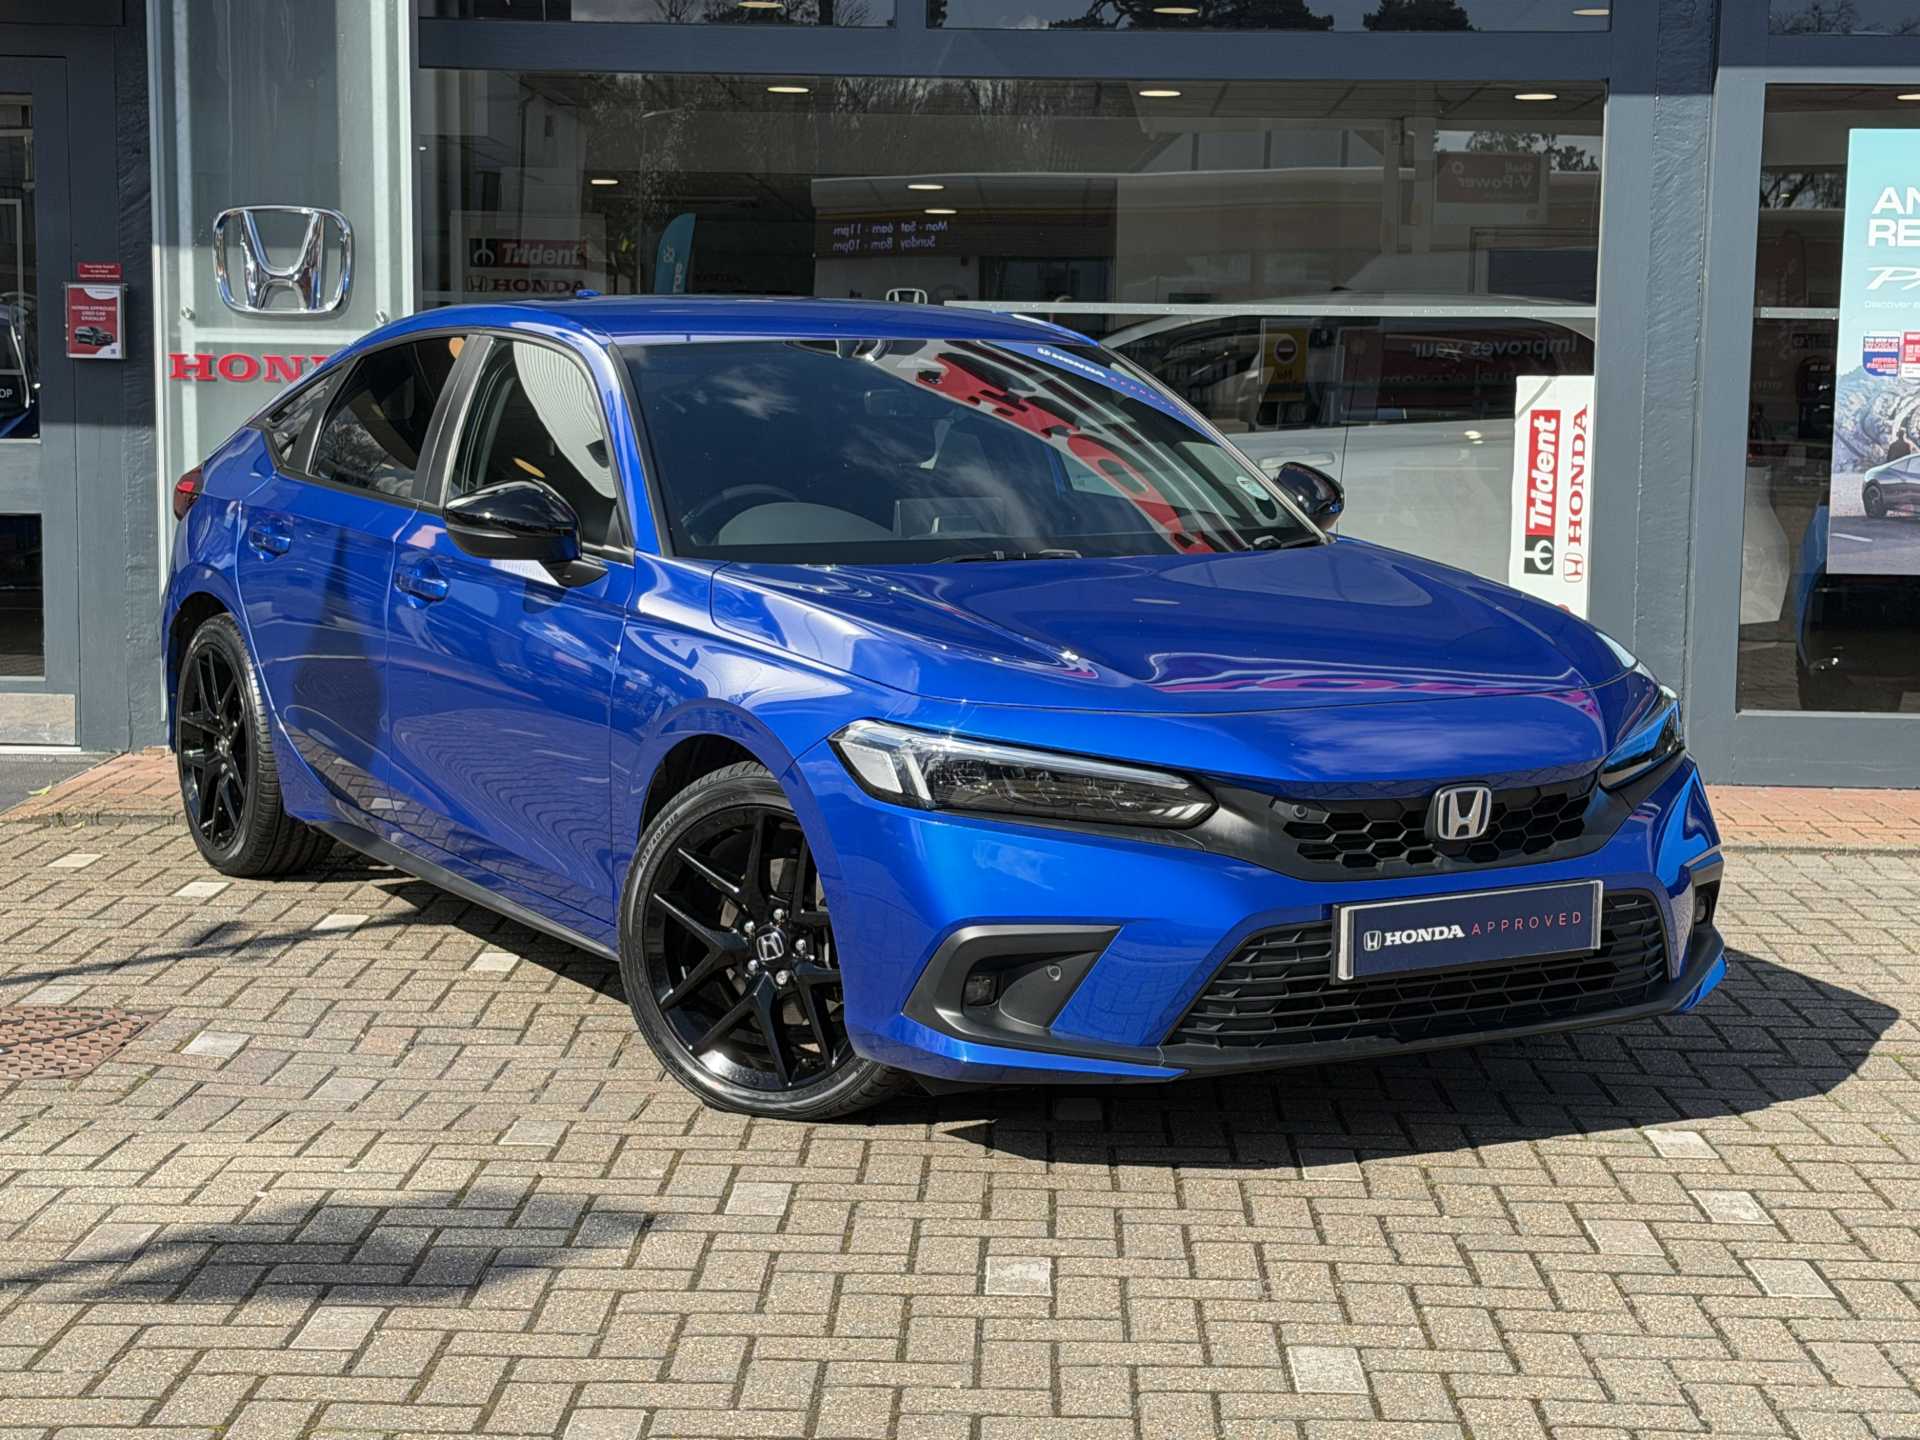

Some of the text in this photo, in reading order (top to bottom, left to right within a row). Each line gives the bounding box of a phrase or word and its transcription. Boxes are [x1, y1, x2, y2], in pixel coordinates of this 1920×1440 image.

[502, 242, 580, 267] Trident
[493, 278, 587, 294] HONDA
[1529, 415, 1557, 529] Trident
[1568, 404, 1588, 547] HONDA
[1384, 911, 1582, 946] HONDA APPROVED
